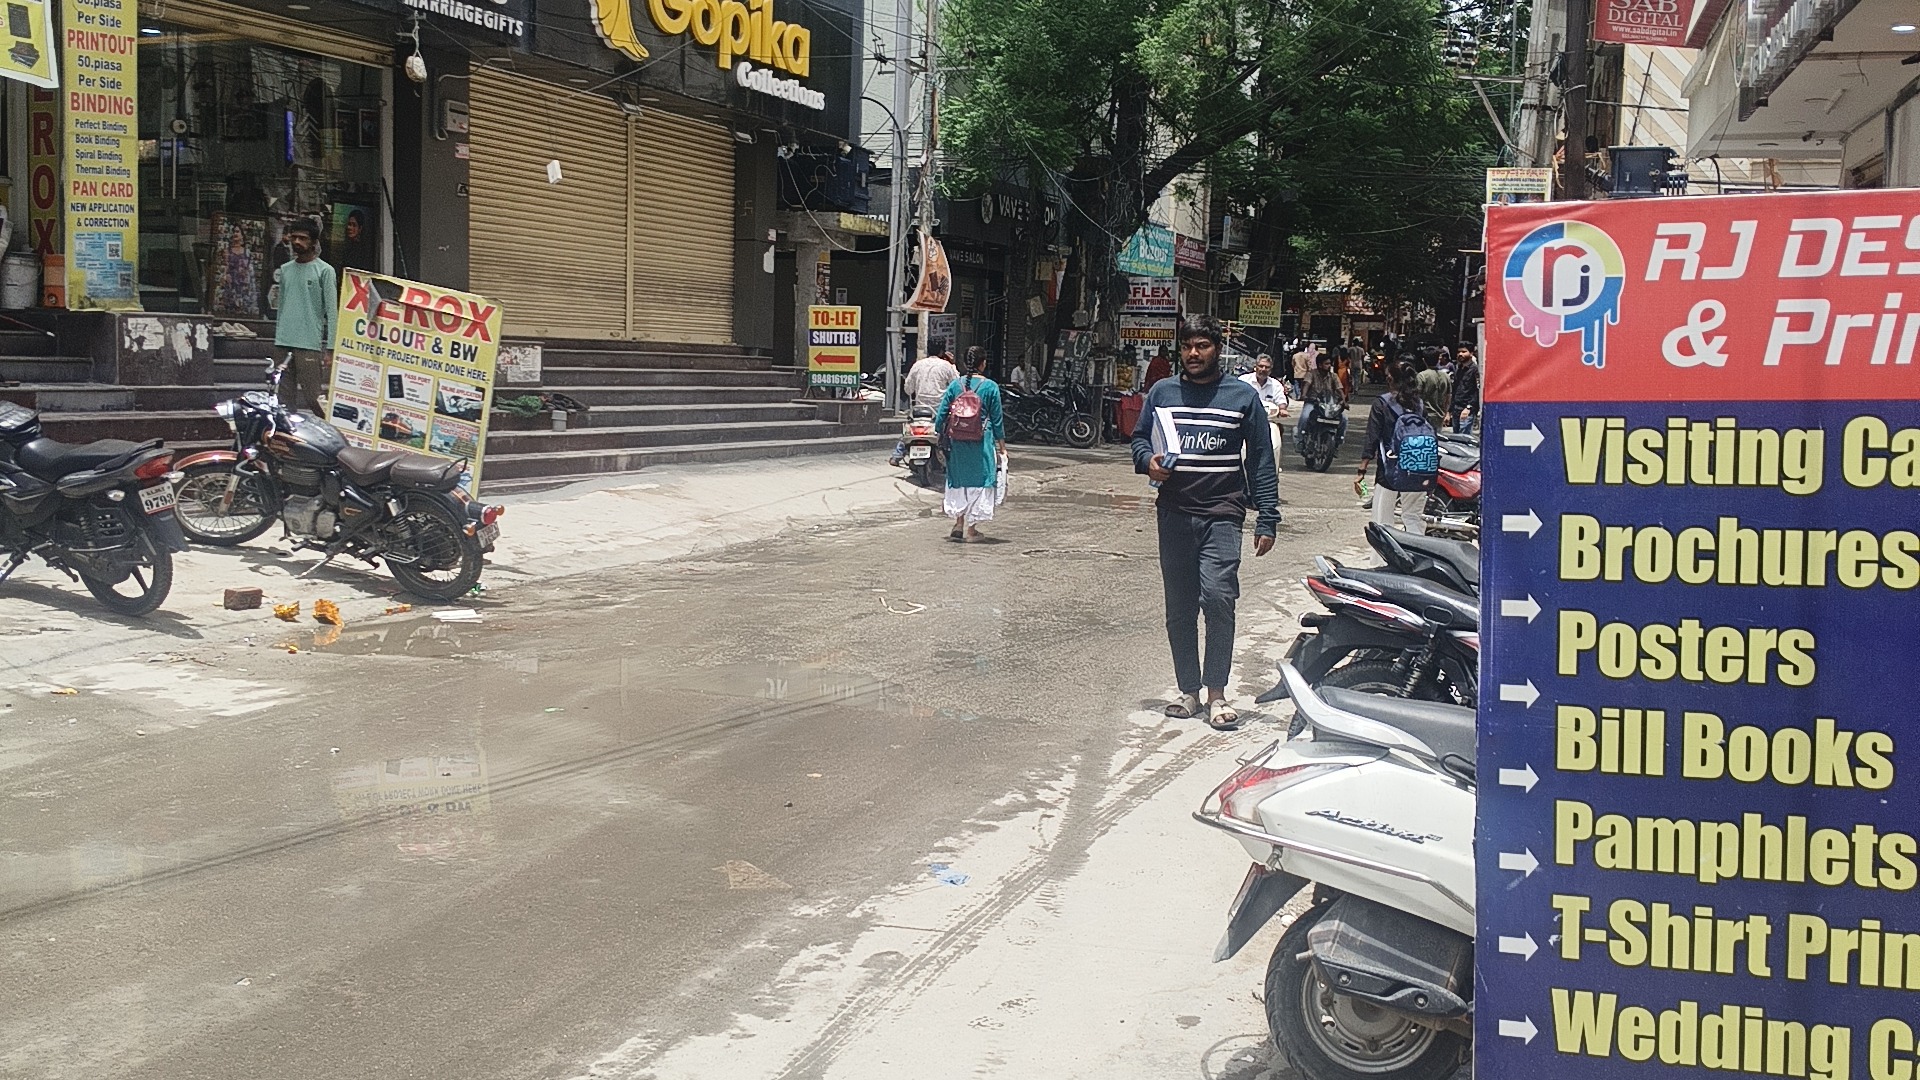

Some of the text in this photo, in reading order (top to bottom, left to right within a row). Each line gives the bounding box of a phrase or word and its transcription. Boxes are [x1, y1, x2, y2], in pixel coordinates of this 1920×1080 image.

[78, 0, 122, 9] .piasa
[78, 11, 121, 28] Per Side
[1608, 9, 1683, 27] DIGITAL
[650, 0, 810, 77] Gopika
[1612, 26, 1677, 36] www.sabdigital.in
[68, 29, 135, 55] PRINTOUT
[78, 55, 122, 71] 50.piasa
[78, 74, 122, 89] Per Side
[737, 62, 825, 110] Collections
[71, 92, 134, 115] BINDING
[75, 119, 127, 134] Perfect Binding
[76, 134, 120, 148] Book Binding
[76, 149, 122, 163] Spiral Binding
[76, 164, 130, 178] Thermal Binding
[72, 181, 133, 197] PAN CARD
[71, 203, 134, 213] NEW APPLICATION
[77, 218, 129, 227] & CORRECTION
[1645, 220, 1758, 282] RJ
[1133, 287, 1171, 297] FLEX
[813, 311, 856, 326] TO-LET
[356, 319, 478, 362] COLOUR & BW
[812, 331, 856, 344] SHUTTER
[1122, 329, 1173, 338] FLEX PRINTING
[1662, 298, 1729, 368] &
[341, 338, 354, 349] ALL
[357, 341, 374, 354] TYPE
[376, 346, 385, 356] OF
[387, 349, 420, 365] PROJECT
[422, 357, 443, 371] WORK
[445, 363, 465, 376] DONE
[1196, 431, 1227, 451] Klein
[1560, 417, 1825, 496] Visiting
[145, 494, 174, 510] 9793
[1558, 514, 1920, 590] Brochures
[1558, 610, 1817, 686] Posters
[1556, 705, 1895, 790] Bill Books
[1555, 799, 1918, 891] Pamphlets
[1552, 894, 1772, 978] T-Shirt
[1551, 987, 1920, 1080] Wedding C
